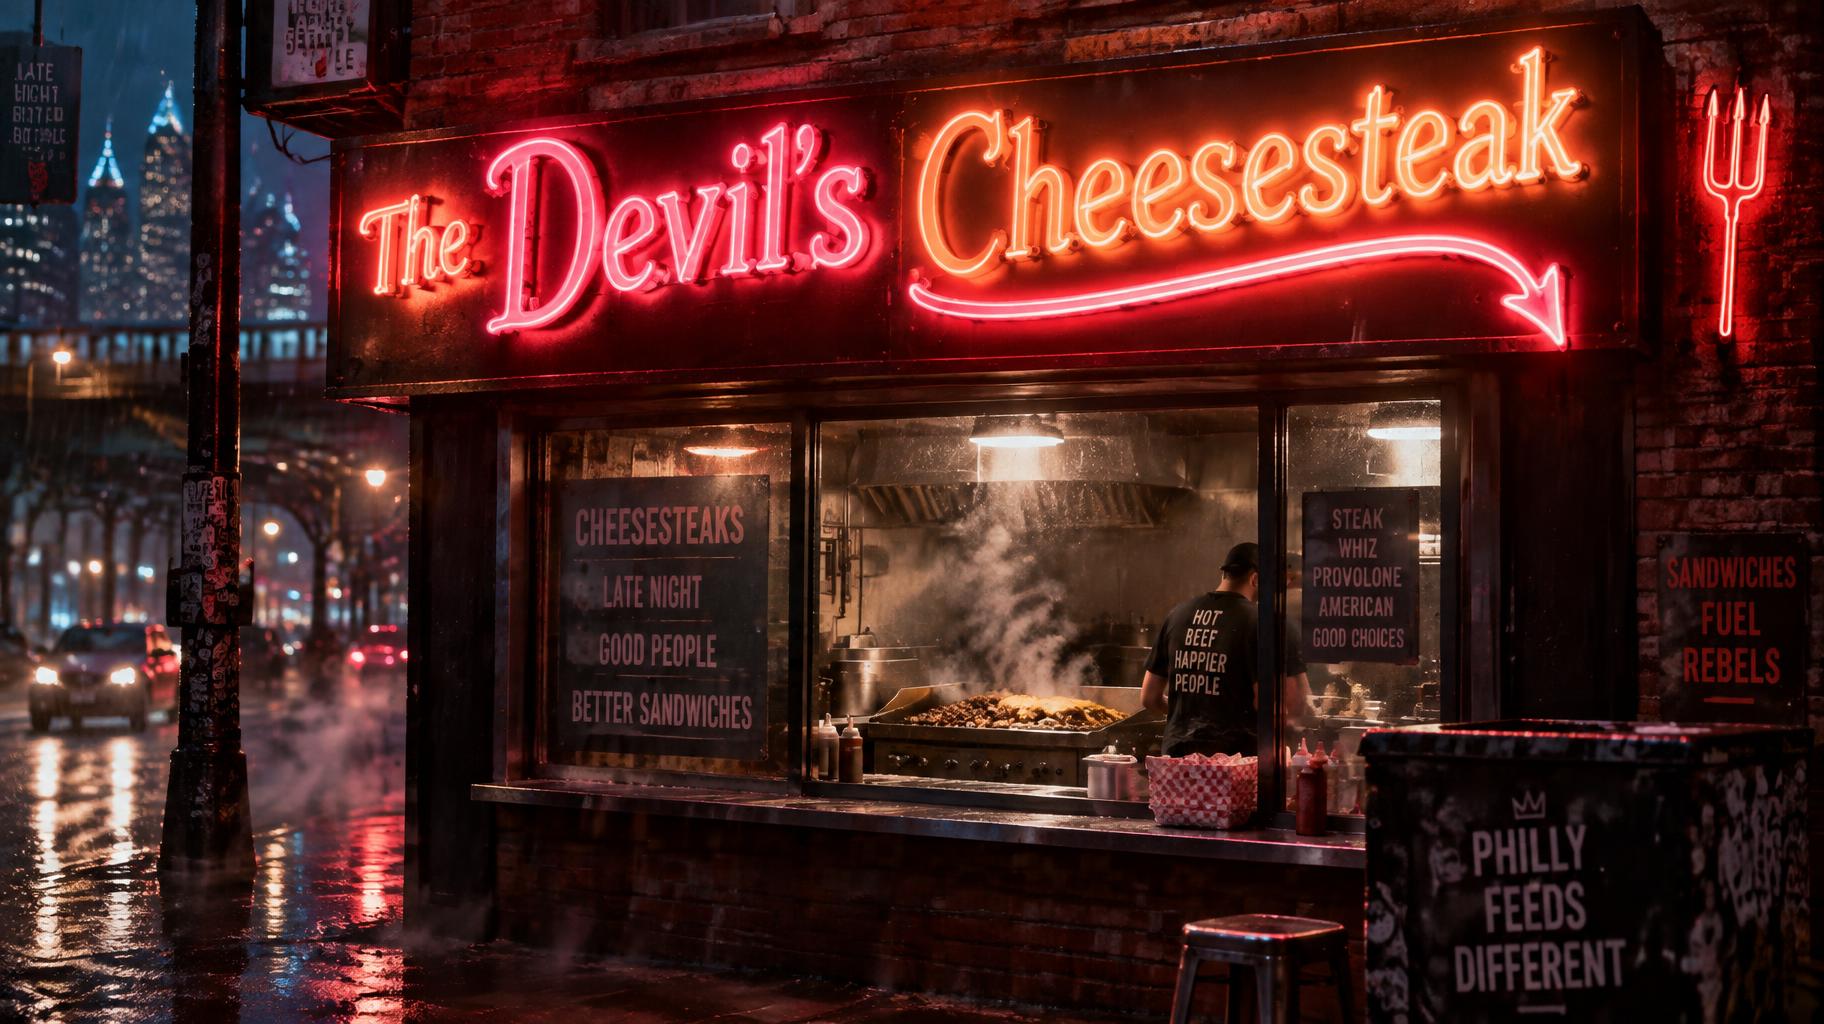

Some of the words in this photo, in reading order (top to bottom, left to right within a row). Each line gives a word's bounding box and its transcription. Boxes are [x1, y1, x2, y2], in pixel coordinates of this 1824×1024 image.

[358, 193, 473, 295] The
[485, 121, 872, 335] Devil's
[918, 45, 1585, 278] Cheesesteak
[575, 505, 745, 546] CHEESESTEAKS
[1332, 508, 1384, 530] STEAK
[1338, 538, 1378, 559] WHIZ
[1312, 566, 1402, 588] PROVOLONE
[1666, 556, 1797, 589] SANDWICHES
[603, 575, 644, 609] LATE
[650, 575, 702, 609] NIGHT
[1318, 596, 1394, 617] AMERICAN
[1192, 609, 1223, 626] HOT
[1701, 601, 1761, 636] FUEL
[600, 633, 645, 667] GOOD
[651, 633, 718, 668] PEOPLE
[1185, 628, 1218, 648] BEEF
[1312, 627, 1347, 648] GOOD
[1351, 627, 1405, 648] CHOICES
[1174, 650, 1228, 674] HAPPIER
[1683, 647, 1781, 685] REBELS
[1175, 673, 1221, 696] PEOPLE
[572, 690, 634, 725] BETTER
[639, 691, 753, 730] SANDWICHES
[1472, 824, 1587, 878] PHILLY
[1484, 881, 1588, 934] FEEDS
[1454, 938, 1626, 993] DIFFERENT
